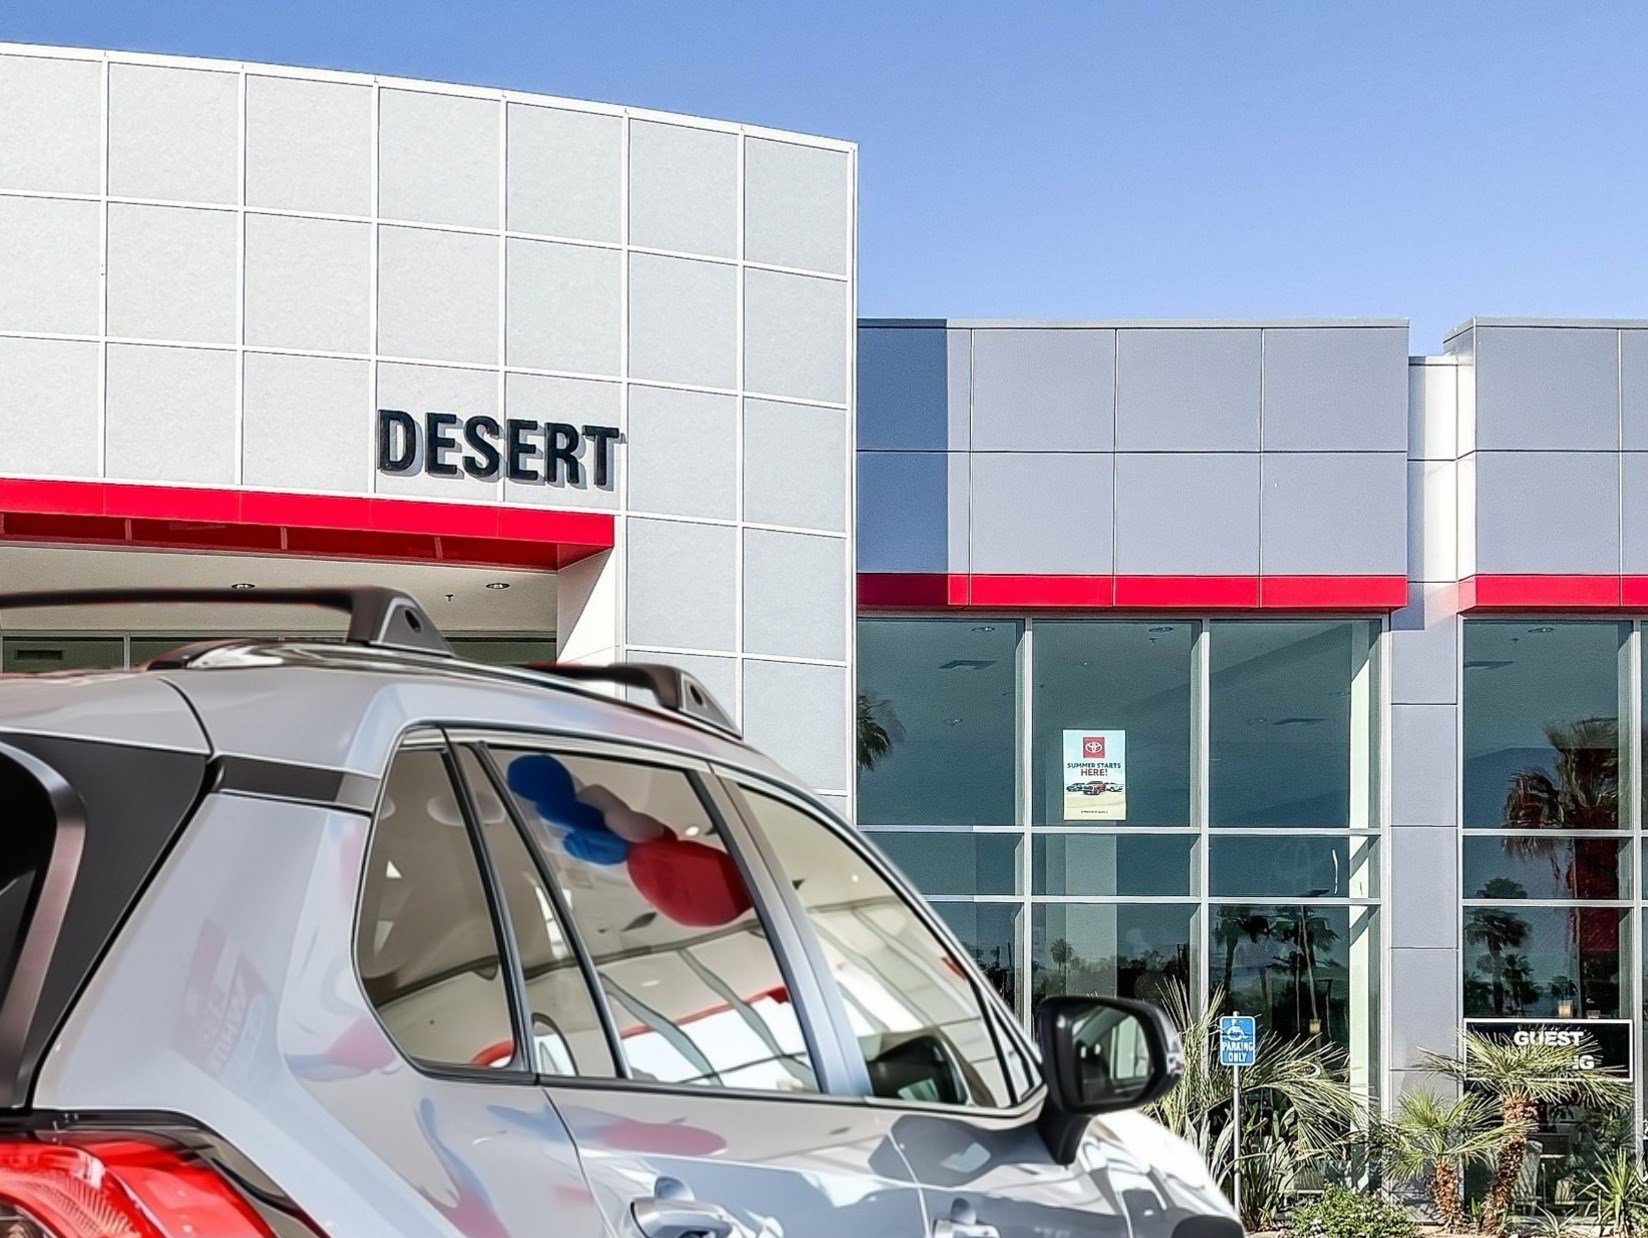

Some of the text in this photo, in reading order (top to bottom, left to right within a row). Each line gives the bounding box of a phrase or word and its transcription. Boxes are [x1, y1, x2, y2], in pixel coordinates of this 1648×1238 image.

[377, 409, 620, 487] DESERT
[1513, 1031, 1584, 1046] GUEST
[1222, 1041, 1253, 1052] PARKING
[1228, 1052, 1247, 1062] ONLY
